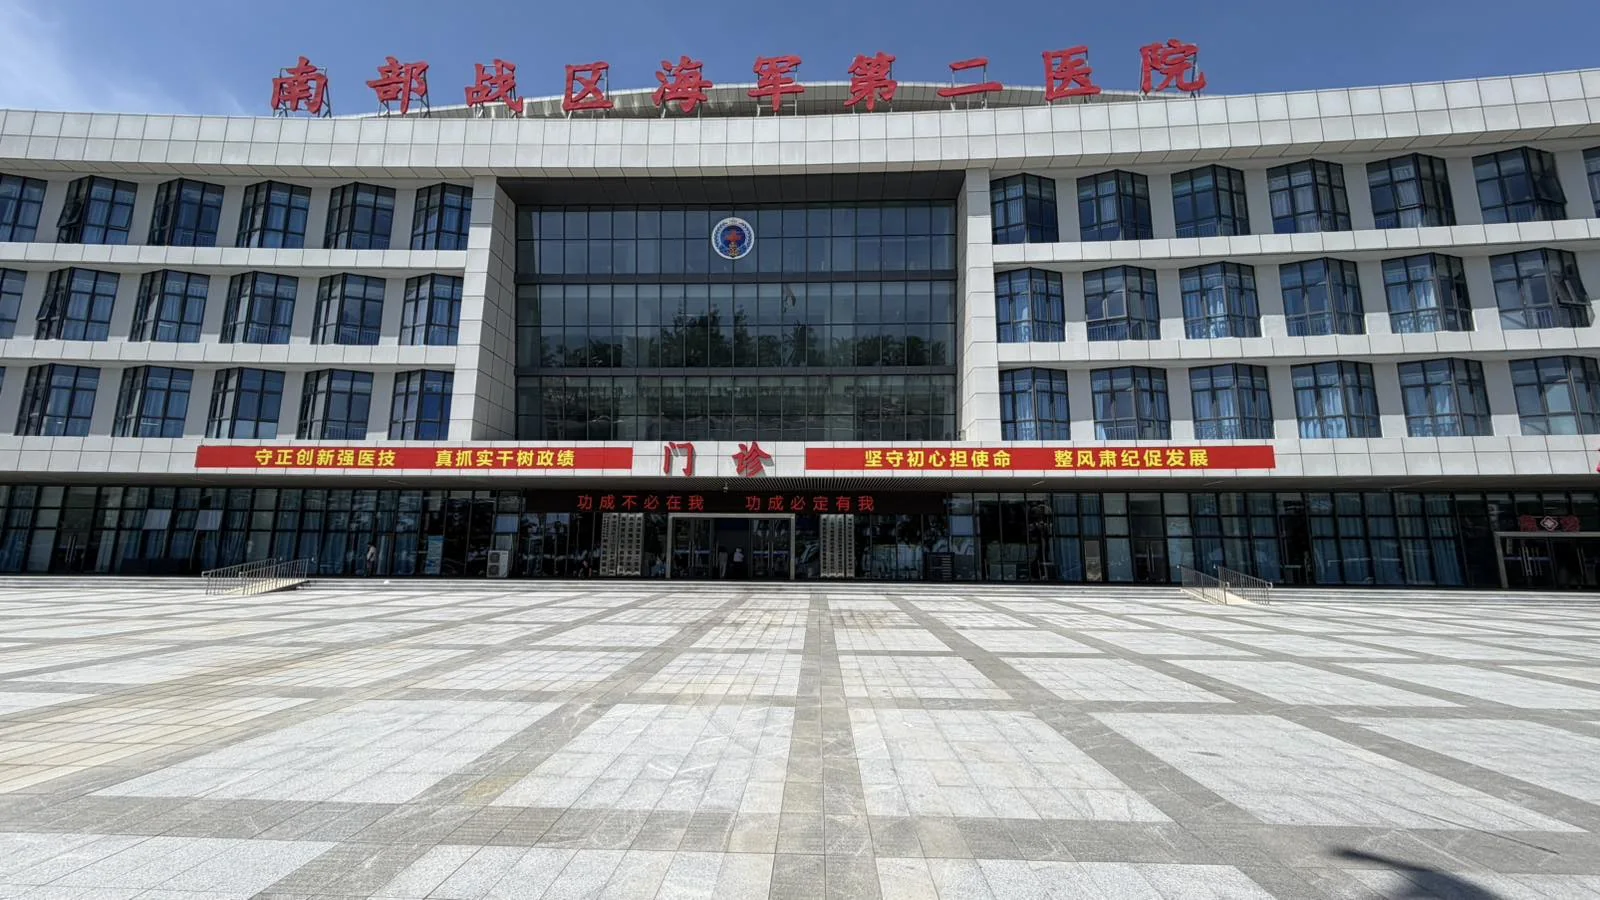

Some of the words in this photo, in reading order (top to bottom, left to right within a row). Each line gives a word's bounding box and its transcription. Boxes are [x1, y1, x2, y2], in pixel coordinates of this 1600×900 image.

[271, 38, 1206, 114] 南部战区海军第二医院
[254, 448, 396, 468] 守正创新强医技
[435, 449, 576, 468] 真抓实干树政绩
[663, 442, 772, 478] 门诊
[864, 449, 1012, 469] 坚守初心担使命
[1054, 448, 1210, 469] 整风肃纪促发展
[577, 494, 705, 511] 功成不必在我
[745, 494, 875, 512] 功成必定有我
